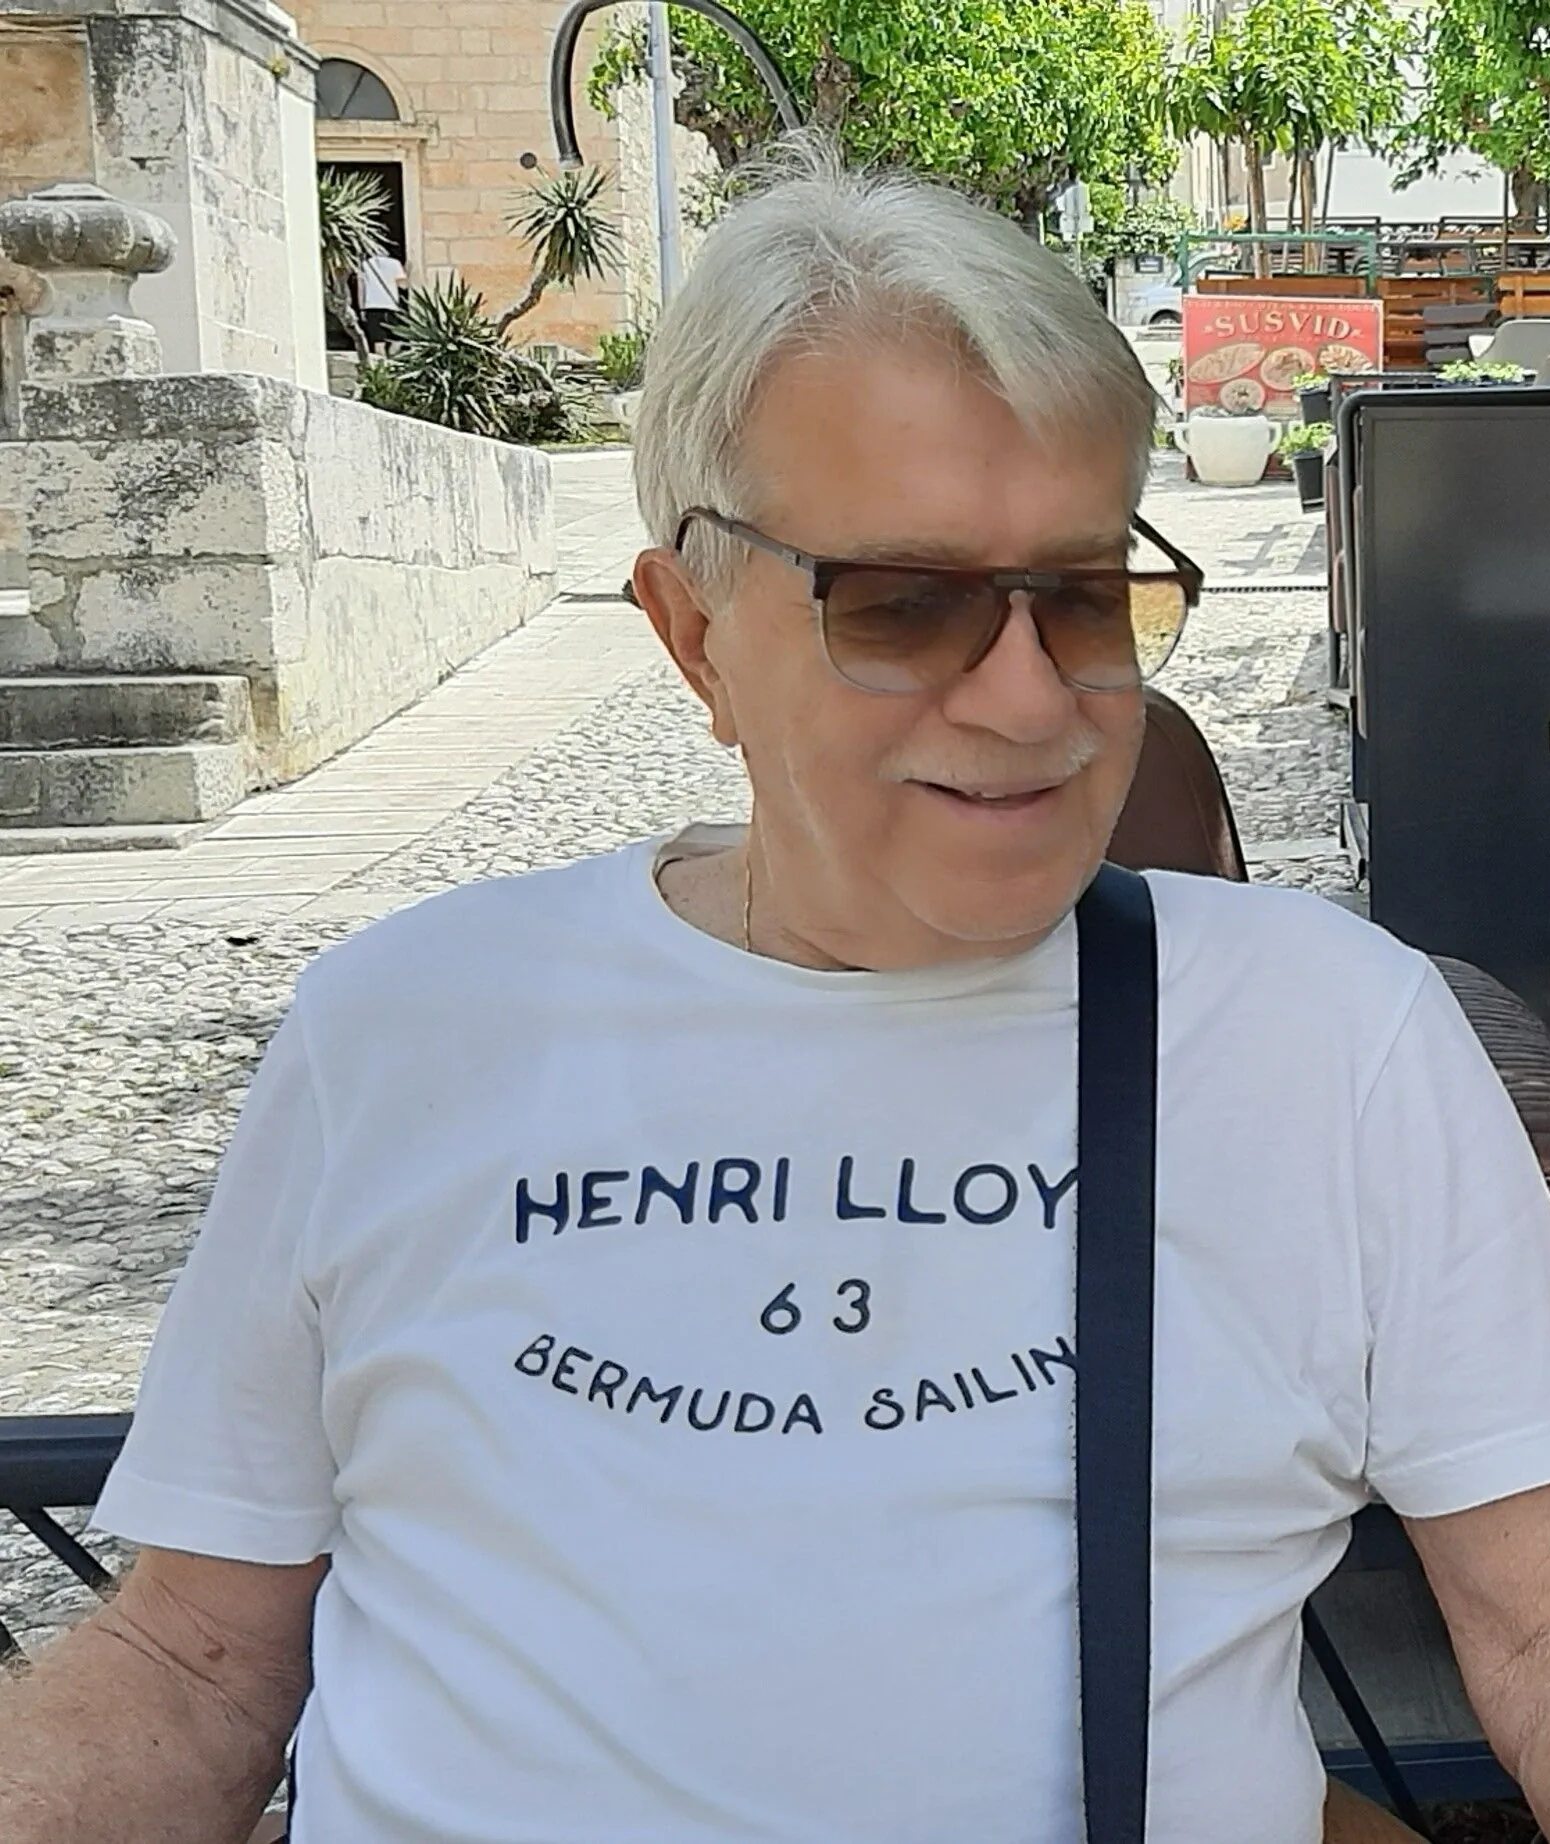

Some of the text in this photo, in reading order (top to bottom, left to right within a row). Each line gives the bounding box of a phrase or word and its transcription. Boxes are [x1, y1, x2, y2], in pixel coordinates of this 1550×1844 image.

[1214, 310, 1351, 340] SUSVID
[515, 1155, 1080, 1244] HENRI LLOY
[514, 1333, 1079, 1434] BERMUDA SAILIN
